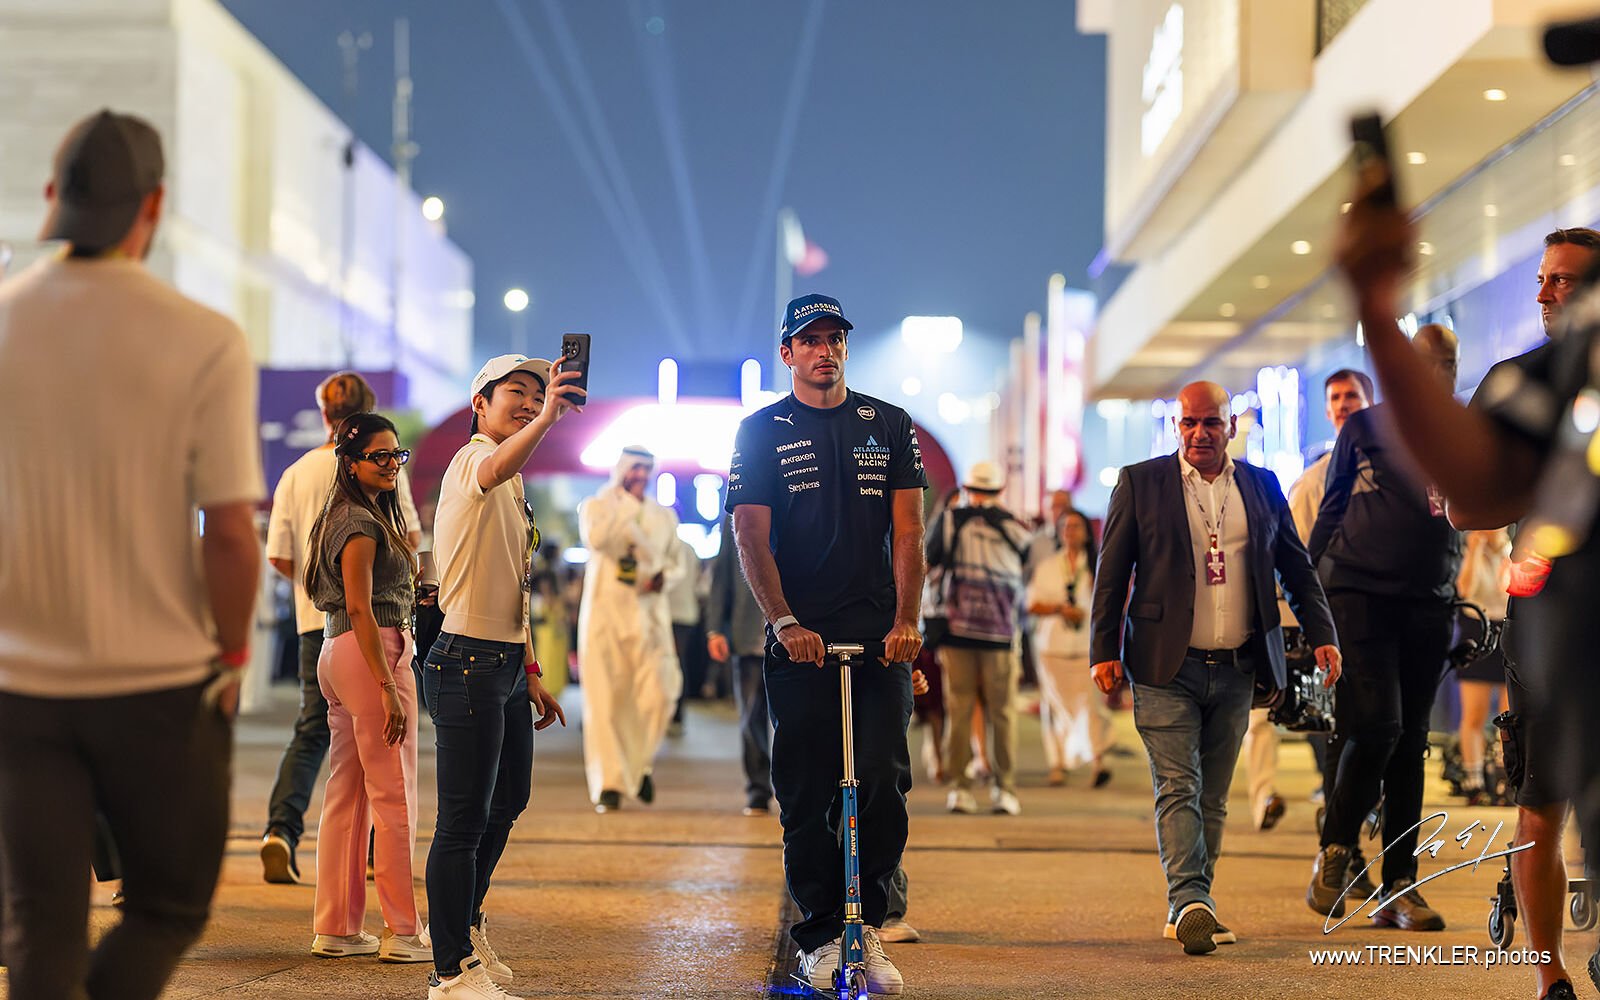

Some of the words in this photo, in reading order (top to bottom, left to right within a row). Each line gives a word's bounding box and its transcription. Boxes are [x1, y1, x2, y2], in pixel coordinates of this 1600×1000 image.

[801, 303, 840, 312] ATLASSIAN
[776, 440, 812, 453] KOMATSU
[858, 460, 887, 468] RACING
[788, 481, 820, 493] Stephens
